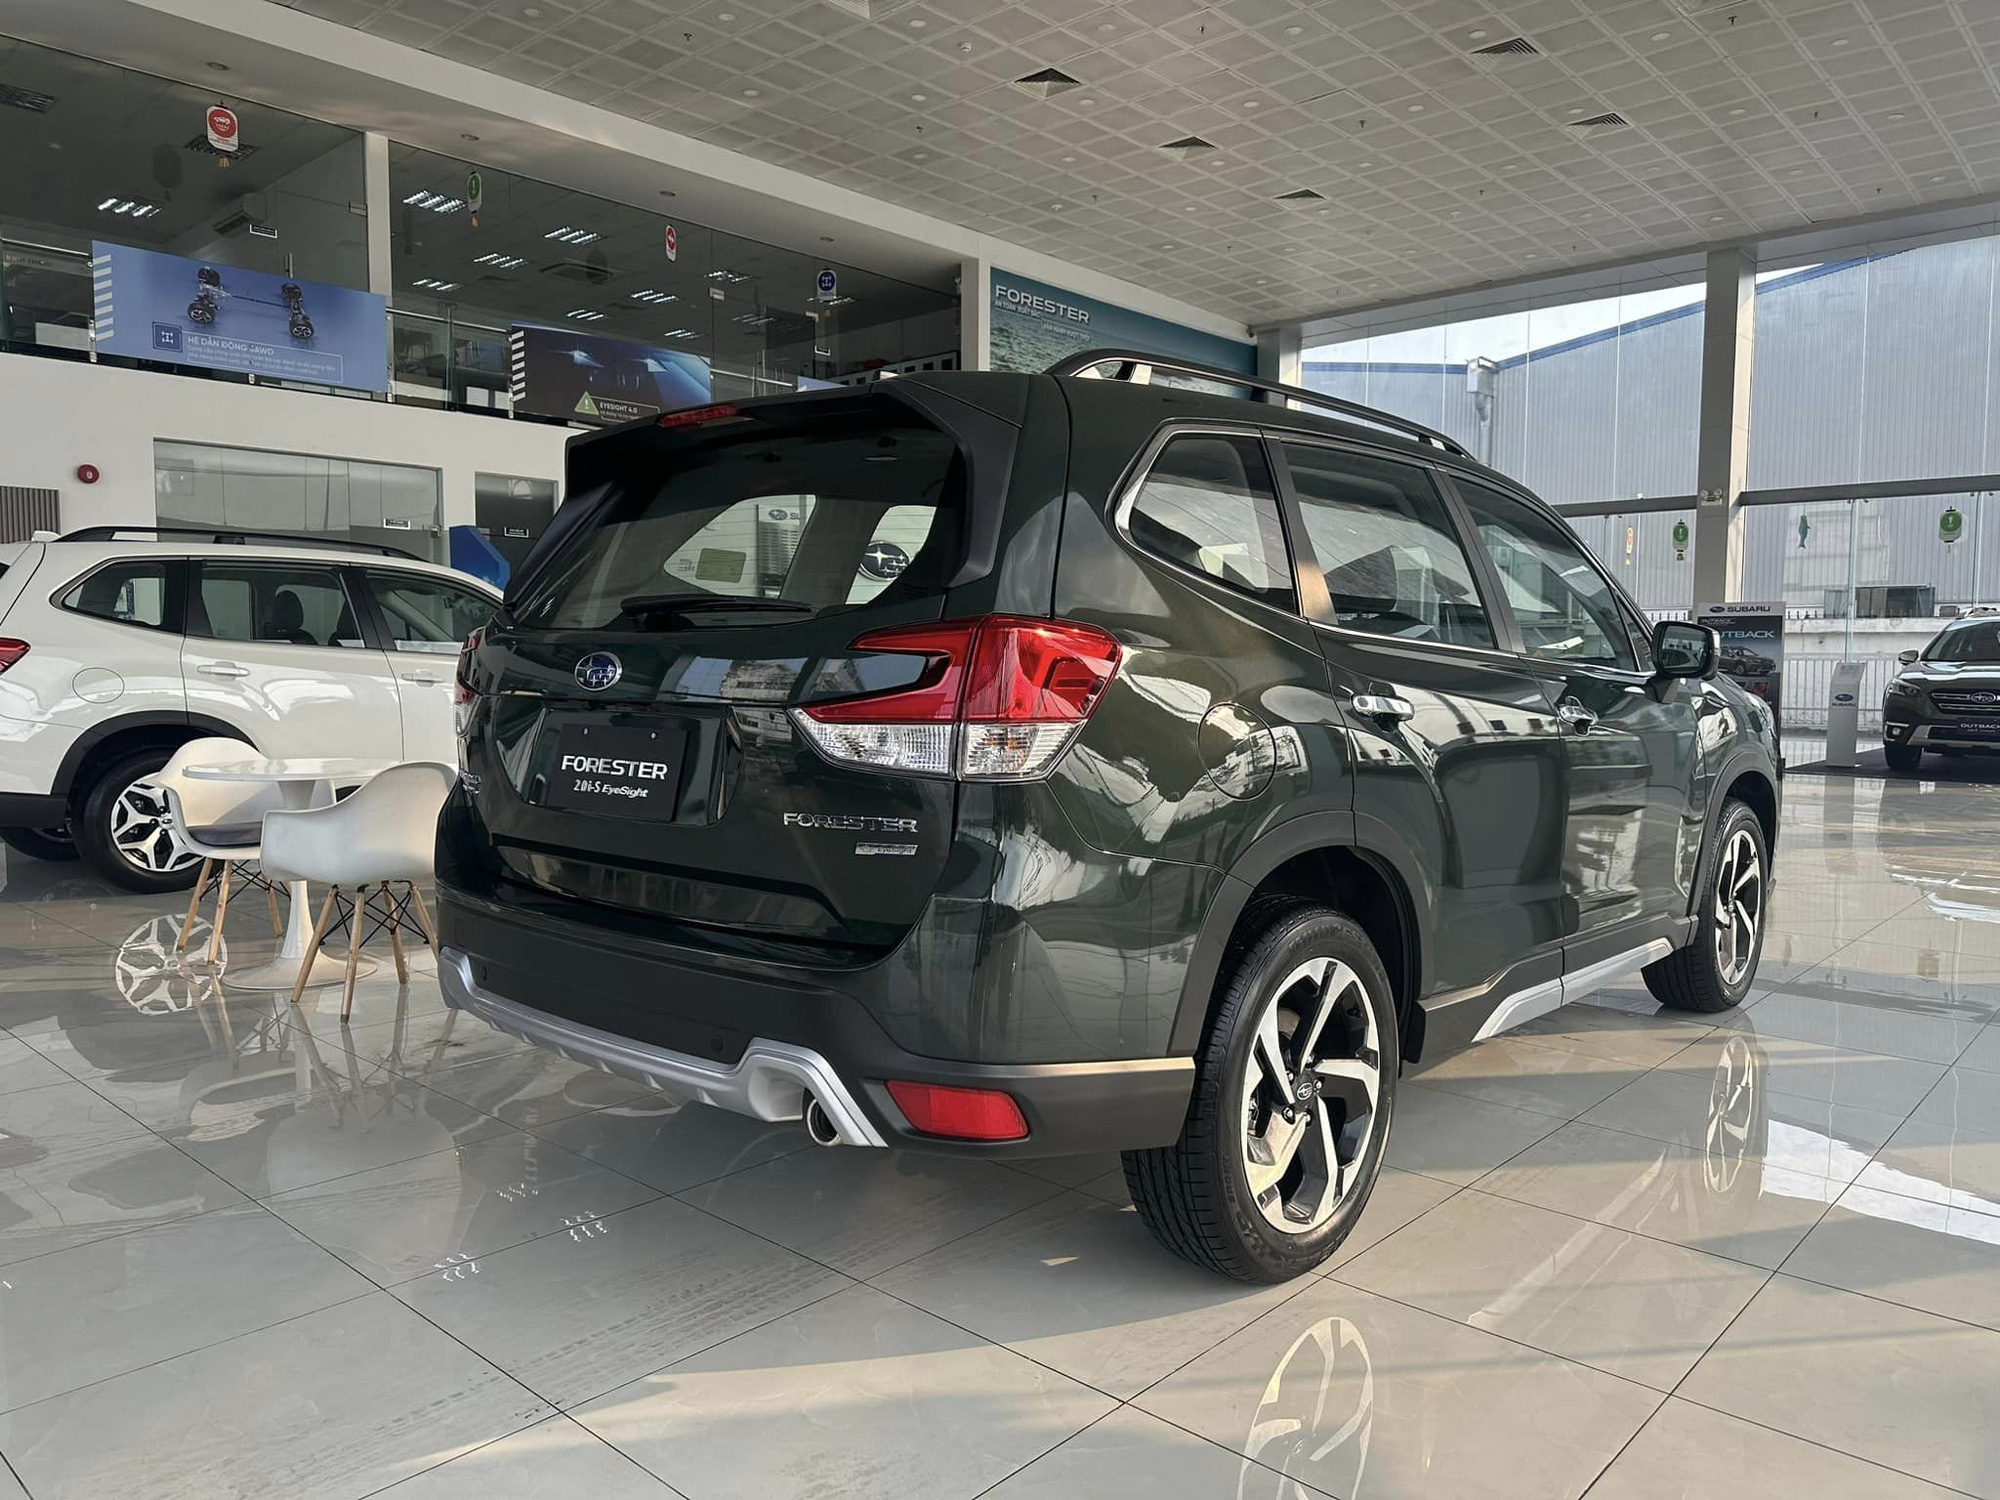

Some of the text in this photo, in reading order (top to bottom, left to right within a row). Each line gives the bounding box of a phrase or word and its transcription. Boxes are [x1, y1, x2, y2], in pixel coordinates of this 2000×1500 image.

[995, 284, 1090, 324] FORESTER
[1727, 605, 1771, 613] SUBARU
[1720, 630, 1775, 639] TBACK
[560, 755, 669, 780] FORESTER
[601, 784, 649, 799] EyeSight
[783, 811, 919, 833] FORESTER
